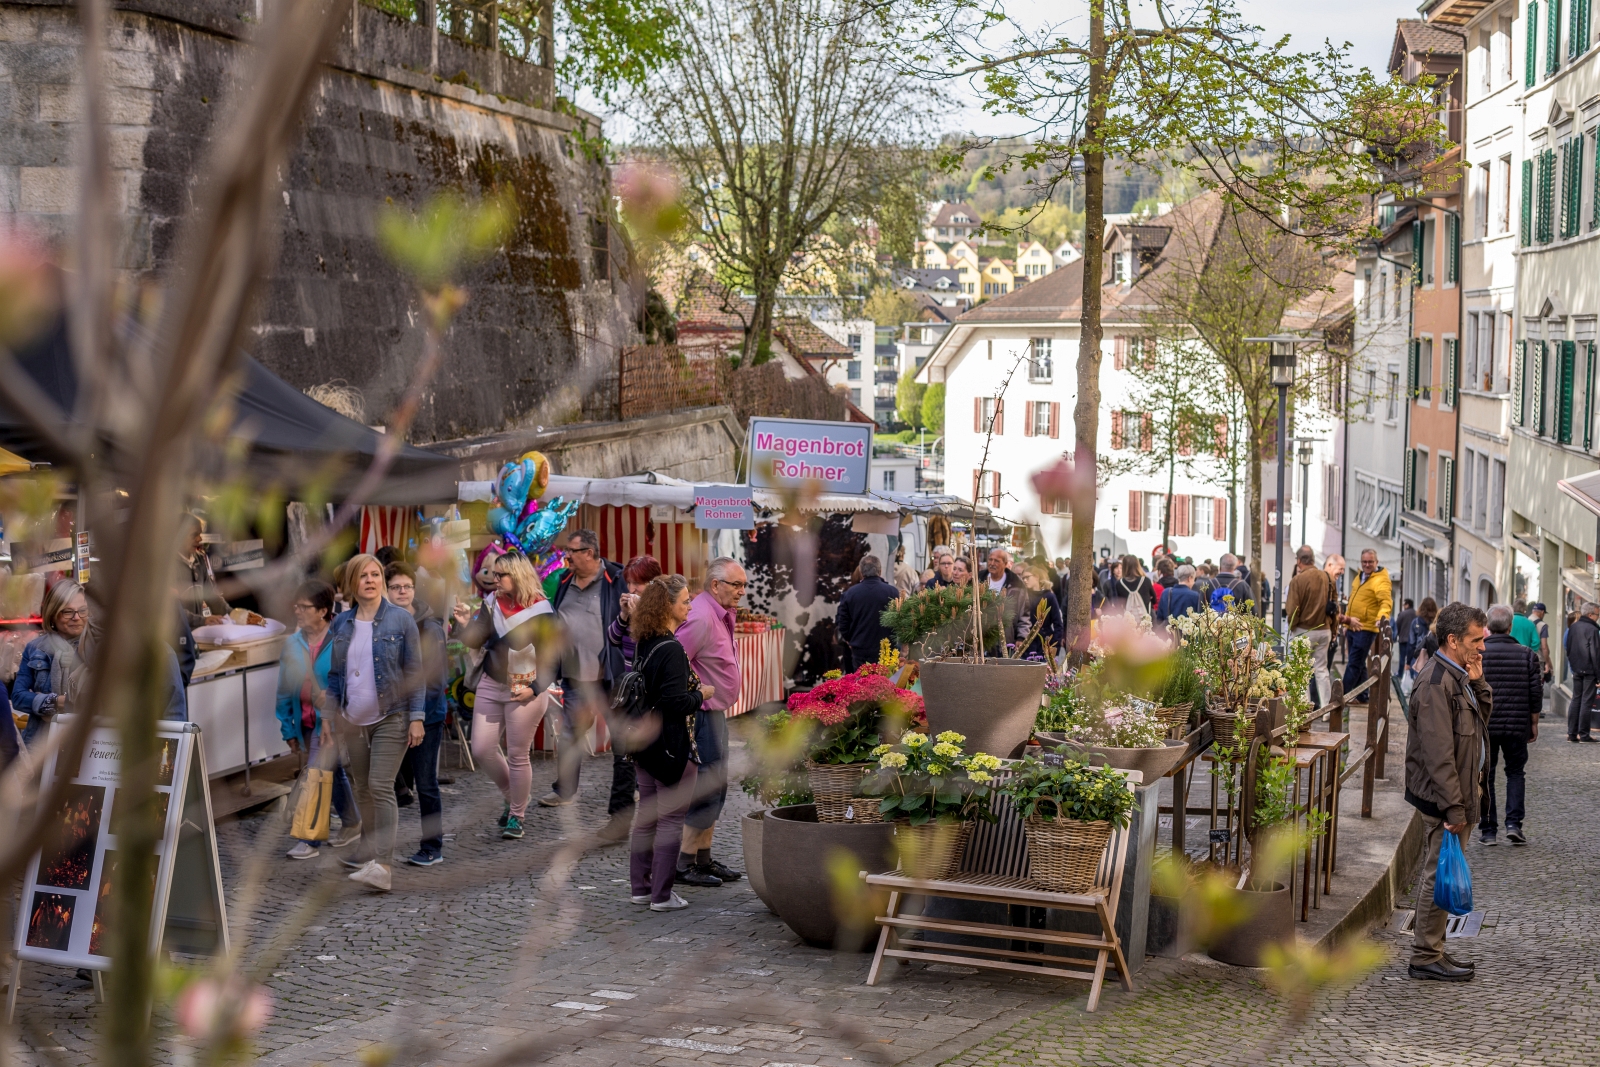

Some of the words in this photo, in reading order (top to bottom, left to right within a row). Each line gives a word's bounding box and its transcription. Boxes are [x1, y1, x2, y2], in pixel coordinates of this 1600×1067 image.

[757, 433, 864, 457] Magenbrot
[696, 496, 751, 508] Magenbrot
[89, 747, 122, 760] Feuerla
